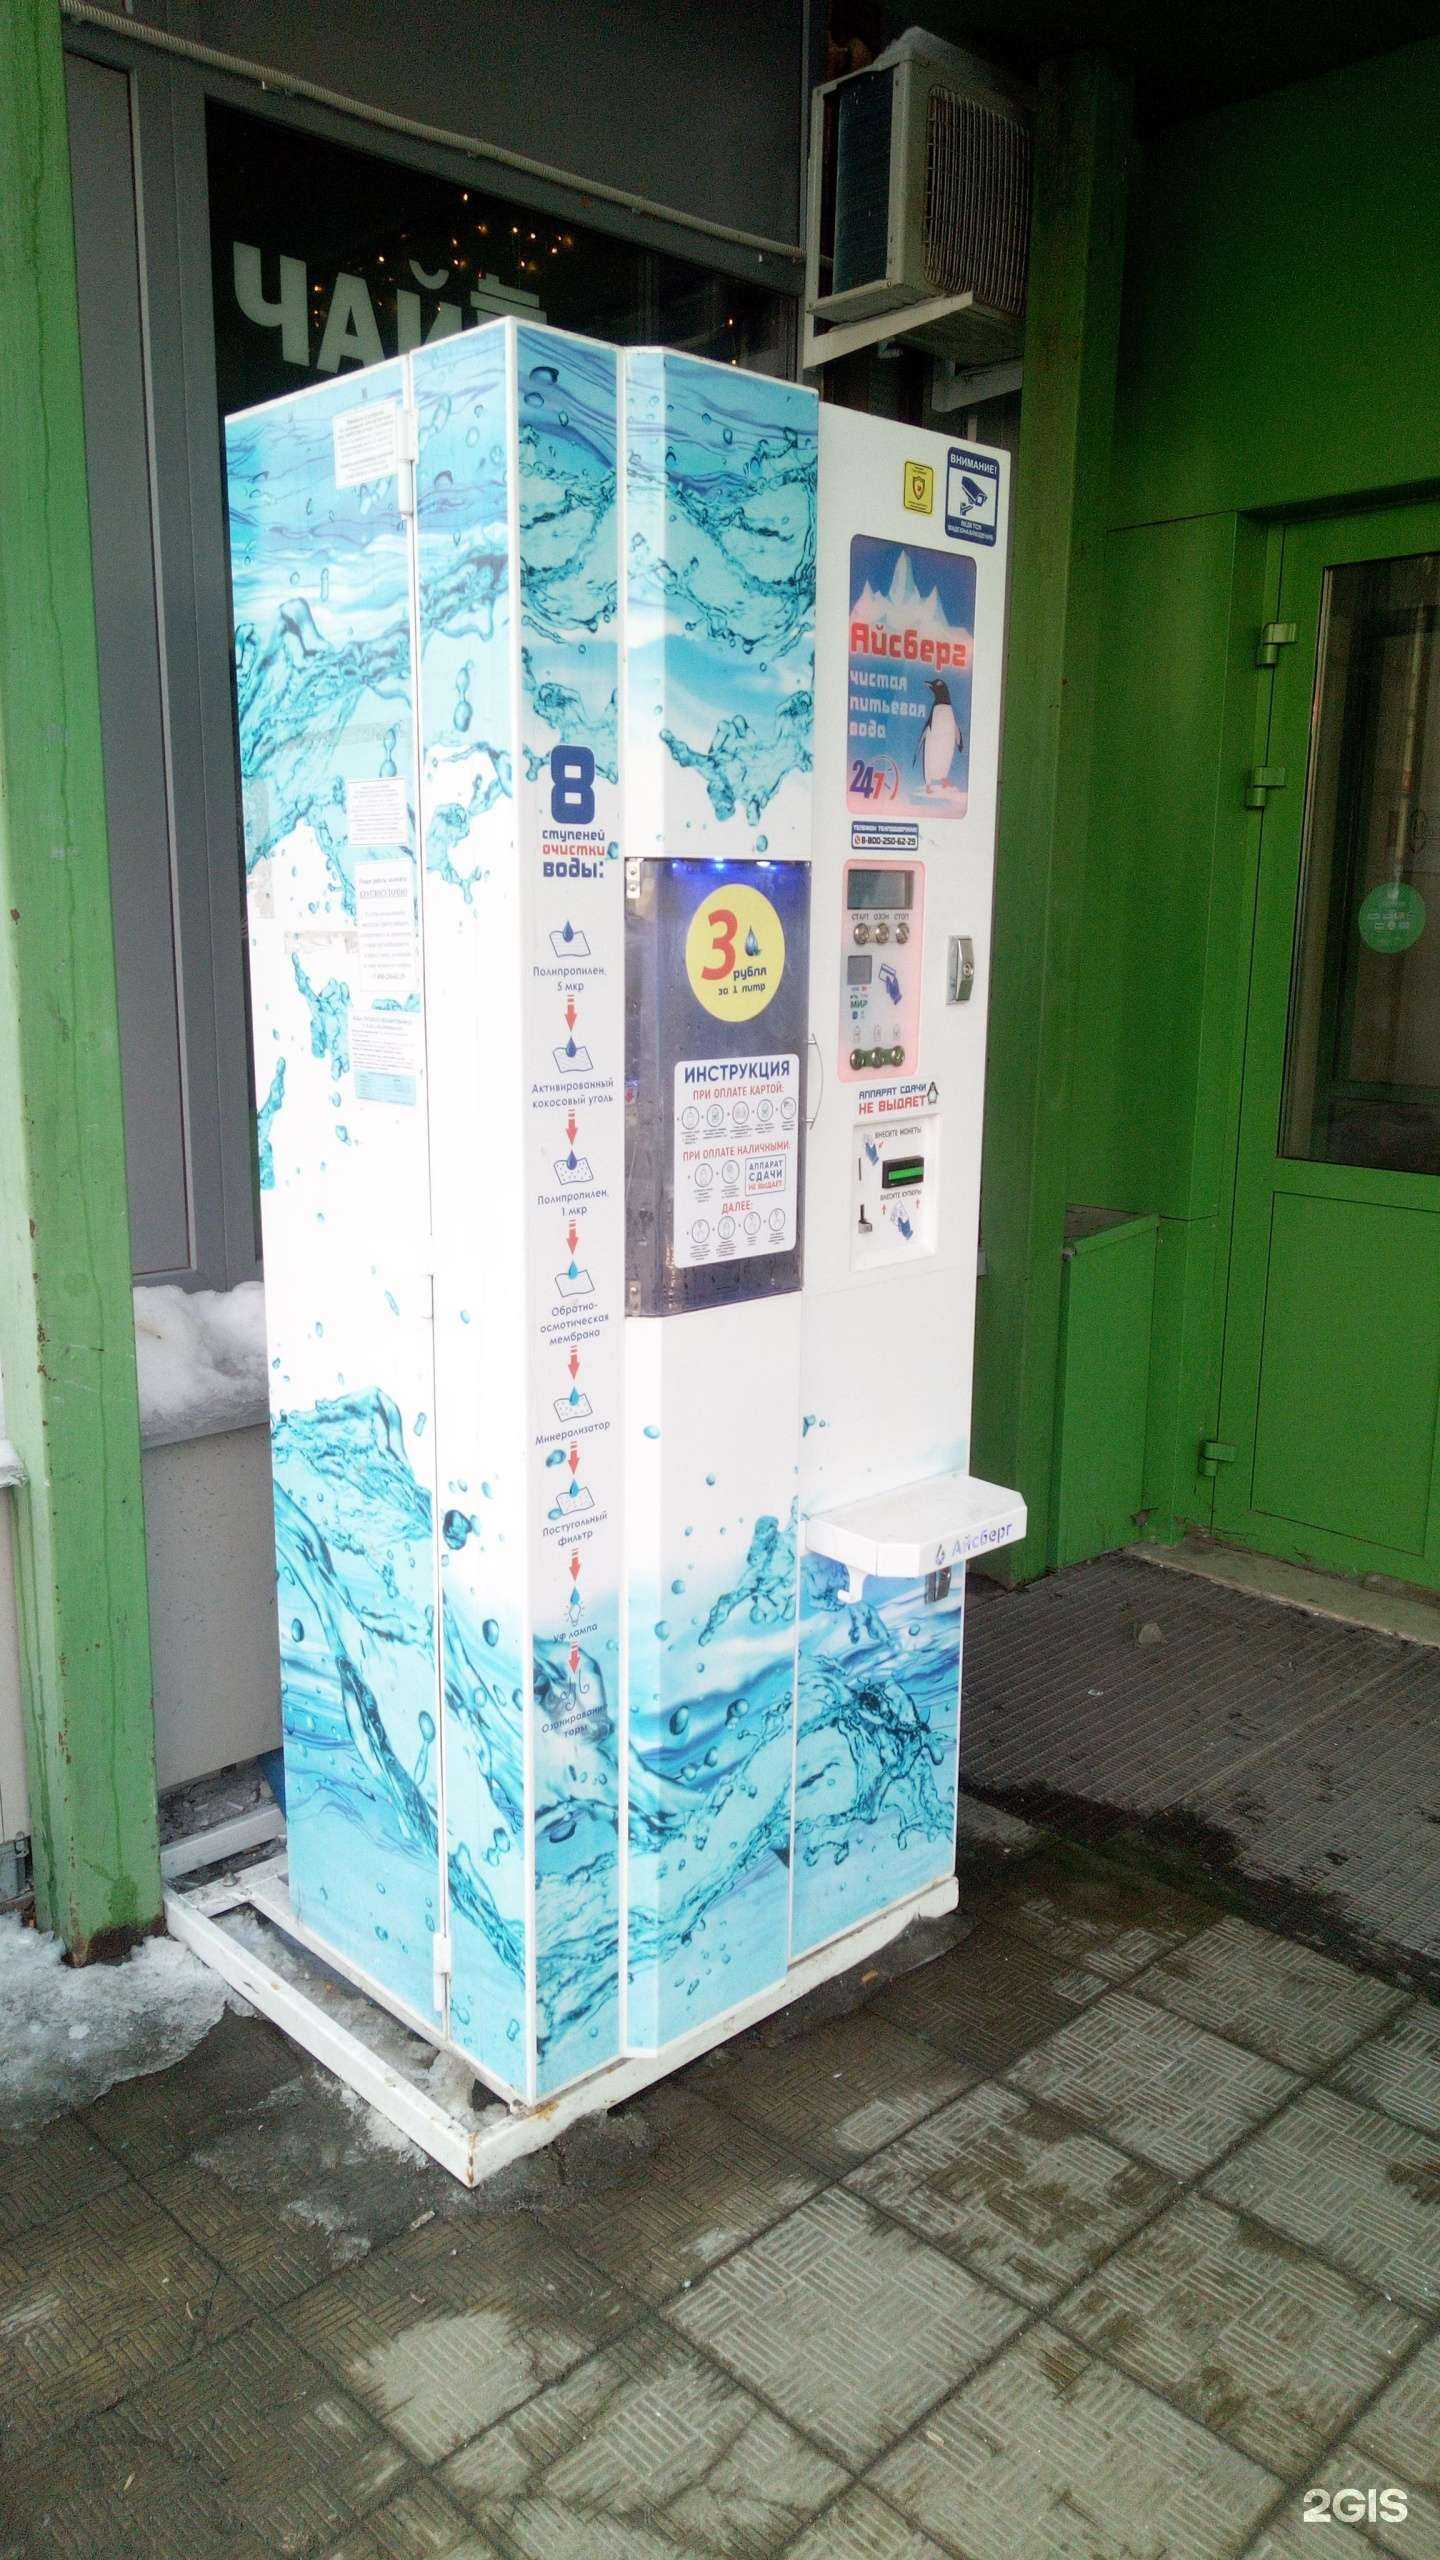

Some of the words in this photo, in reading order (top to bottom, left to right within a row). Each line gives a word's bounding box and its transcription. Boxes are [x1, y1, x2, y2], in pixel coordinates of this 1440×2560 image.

[950, 453, 997, 475] ВНИМАНИЕ!
[850, 622, 967, 672] Айсберг
[849, 670, 908, 692] чистая
[849, 696, 927, 718] питьевая
[849, 720, 887, 739] вода
[551, 745, 595, 825] 8
[542, 829, 605, 842] ступеней
[542, 844, 605, 857] очистки
[543, 858, 605, 878] воды:
[701, 908, 738, 981] 3
[733, 966, 767, 981] рубля
[565, 982, 584, 993] мкр
[718, 988, 729, 996] за
[742, 983, 766, 993] литр
[684, 1060, 791, 1084] ИНСТРУКЦИЯ
[532, 1077, 614, 1094] Активированный
[693, 1088, 712, 1101] ПРИ
[714, 1085, 748, 1099] ОПЛАТЕ
[750, 1081, 785, 1096] КАРТОЙ:
[859, 1087, 898, 1100] АППАРАТ
[900, 1083, 927, 1095] СДАЧИ
[532, 1097, 586, 1109] кокосовый
[589, 1095, 613, 1107] уголь
[858, 1103, 874, 1116] НЕ
[878, 1095, 927, 1112] ВЫДАЕТ
[683, 1149, 702, 1162] ПРИ
[703, 1146, 736, 1160] ОПЛАТЕ
[749, 1159, 783, 1171] АППАРАТ
[748, 1169, 783, 1182] СДАЧИ
[568, 1206, 588, 1217] мкр
[721, 1200, 753, 1215] ДАЛЕЕ:
[551, 1302, 598, 1317] Обратно-
[540, 1312, 609, 1334] осмотическая
[549, 1328, 601, 1346] мембрана
[535, 1421, 611, 1446] Минерализатор
[542, 1510, 608, 1537] Постугольный
[557, 1529, 593, 1547] фильтр
[568, 1623, 598, 1639] лампа
